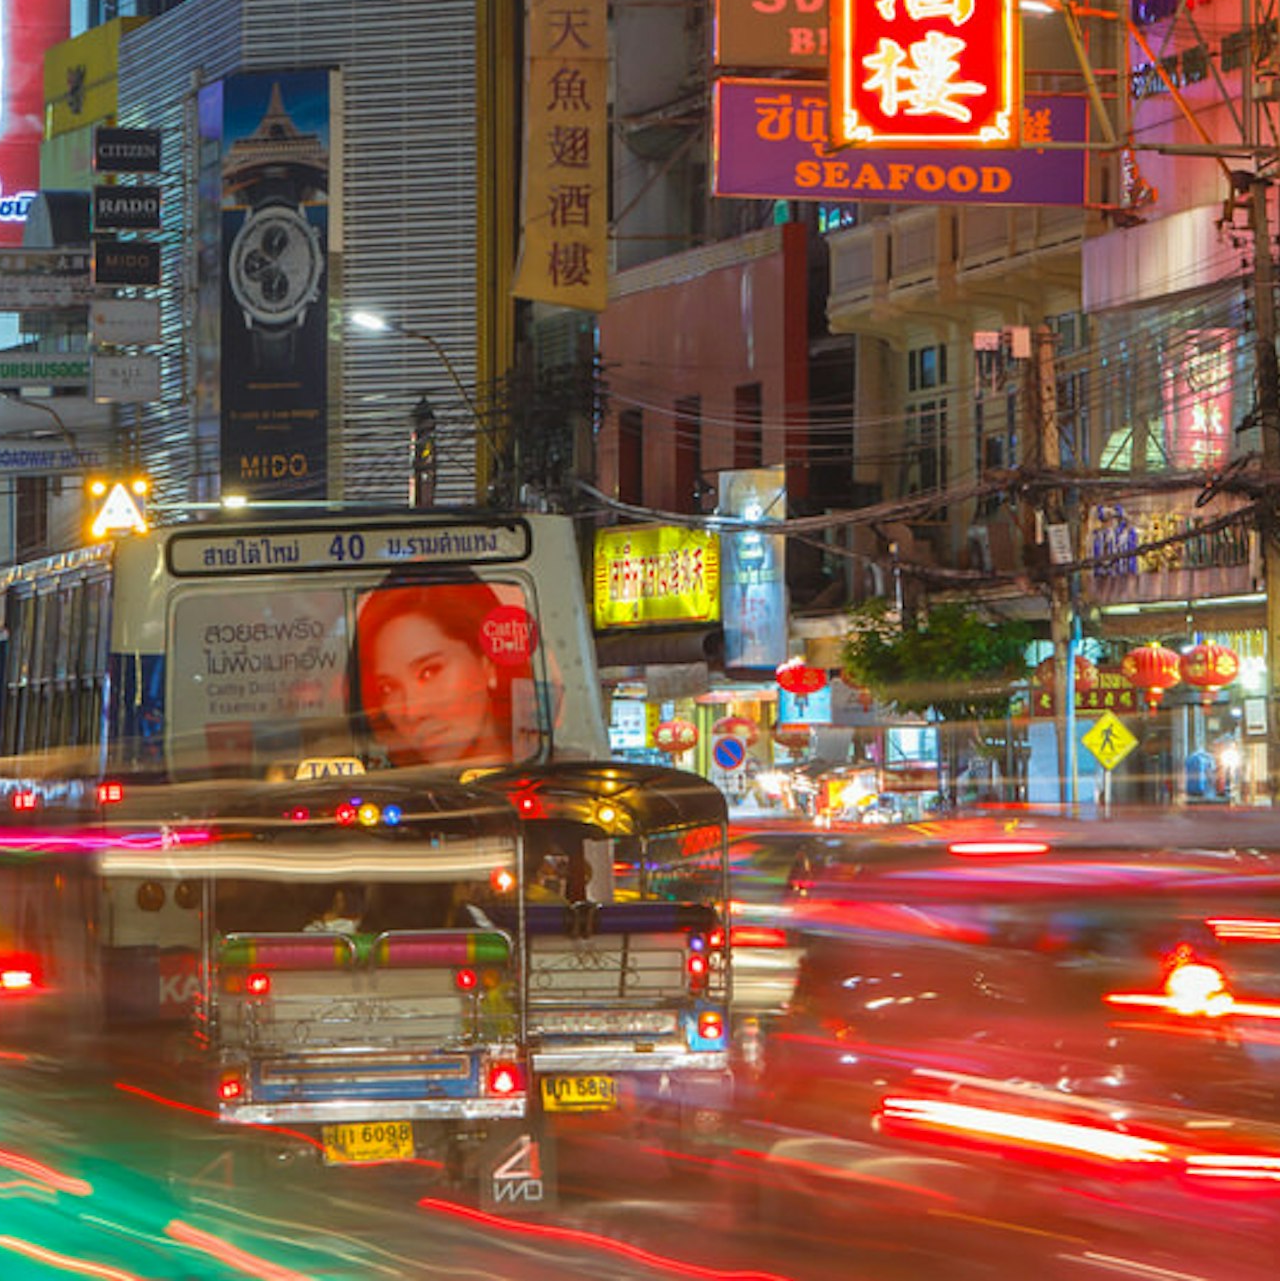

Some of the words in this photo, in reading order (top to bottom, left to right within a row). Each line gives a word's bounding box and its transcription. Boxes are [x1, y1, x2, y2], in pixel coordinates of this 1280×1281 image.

[99, 143, 157, 159] CITIZEN
[793, 161, 1012, 195] SEAFOOD
[98, 197, 158, 215] RADO
[105, 254, 150, 268] MIDO
[240, 453, 309, 479] MIDO
[203, 538, 300, 567] สายใต้ใหม่
[328, 533, 365, 562] 40
[387, 531, 498, 558] ม.รามคำแหง
[483, 620, 534, 642] Cathy
